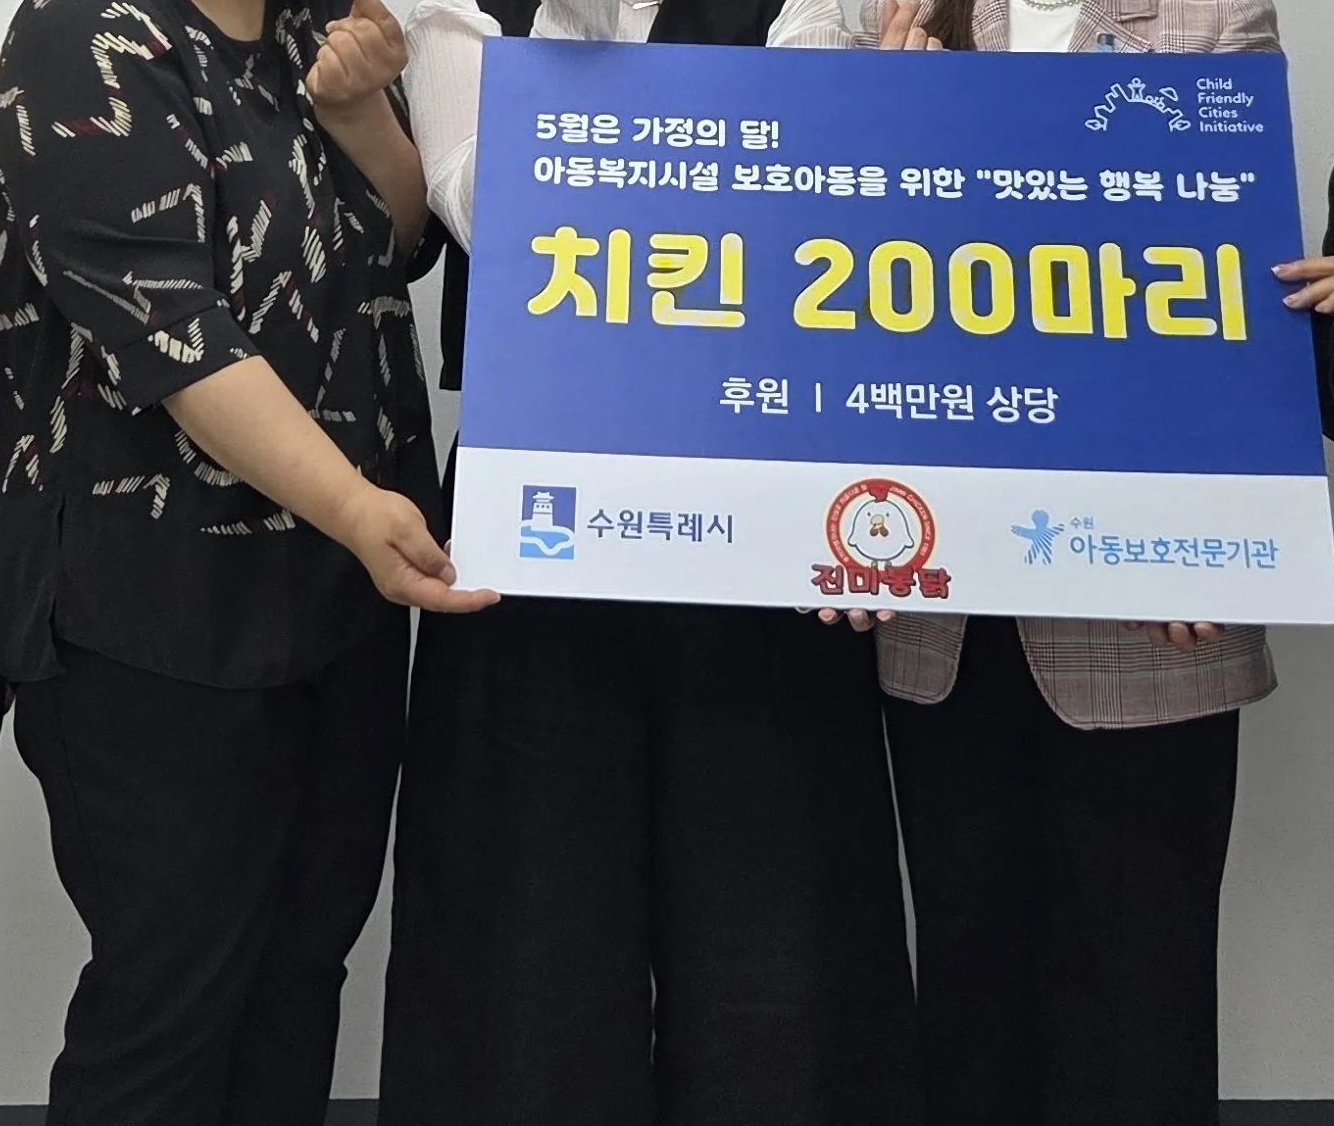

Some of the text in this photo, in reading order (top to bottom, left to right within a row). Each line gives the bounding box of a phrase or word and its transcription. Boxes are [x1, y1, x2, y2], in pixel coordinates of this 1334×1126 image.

[1196, 77, 1233, 90] Child
[1197, 92, 1254, 107] Friendly
[1198, 106, 1238, 118] Cities
[1199, 121, 1264, 132] Initiative
[535, 113, 779, 150] 5월은 가정의 달!
[533, 155, 1255, 203] 아동복지시설 보호아동을 위한 "맛있는 행복 나눔"
[527, 226, 1247, 341] 치킨 200마리
[719, 377, 789, 414] 후원
[845, 382, 974, 421] 4백만원
[986, 386, 1059, 424] 상당
[587, 508, 733, 543] 수원특례시
[1070, 516, 1094, 530] 수원
[1069, 534, 1278, 569] 아동보호전문기관
